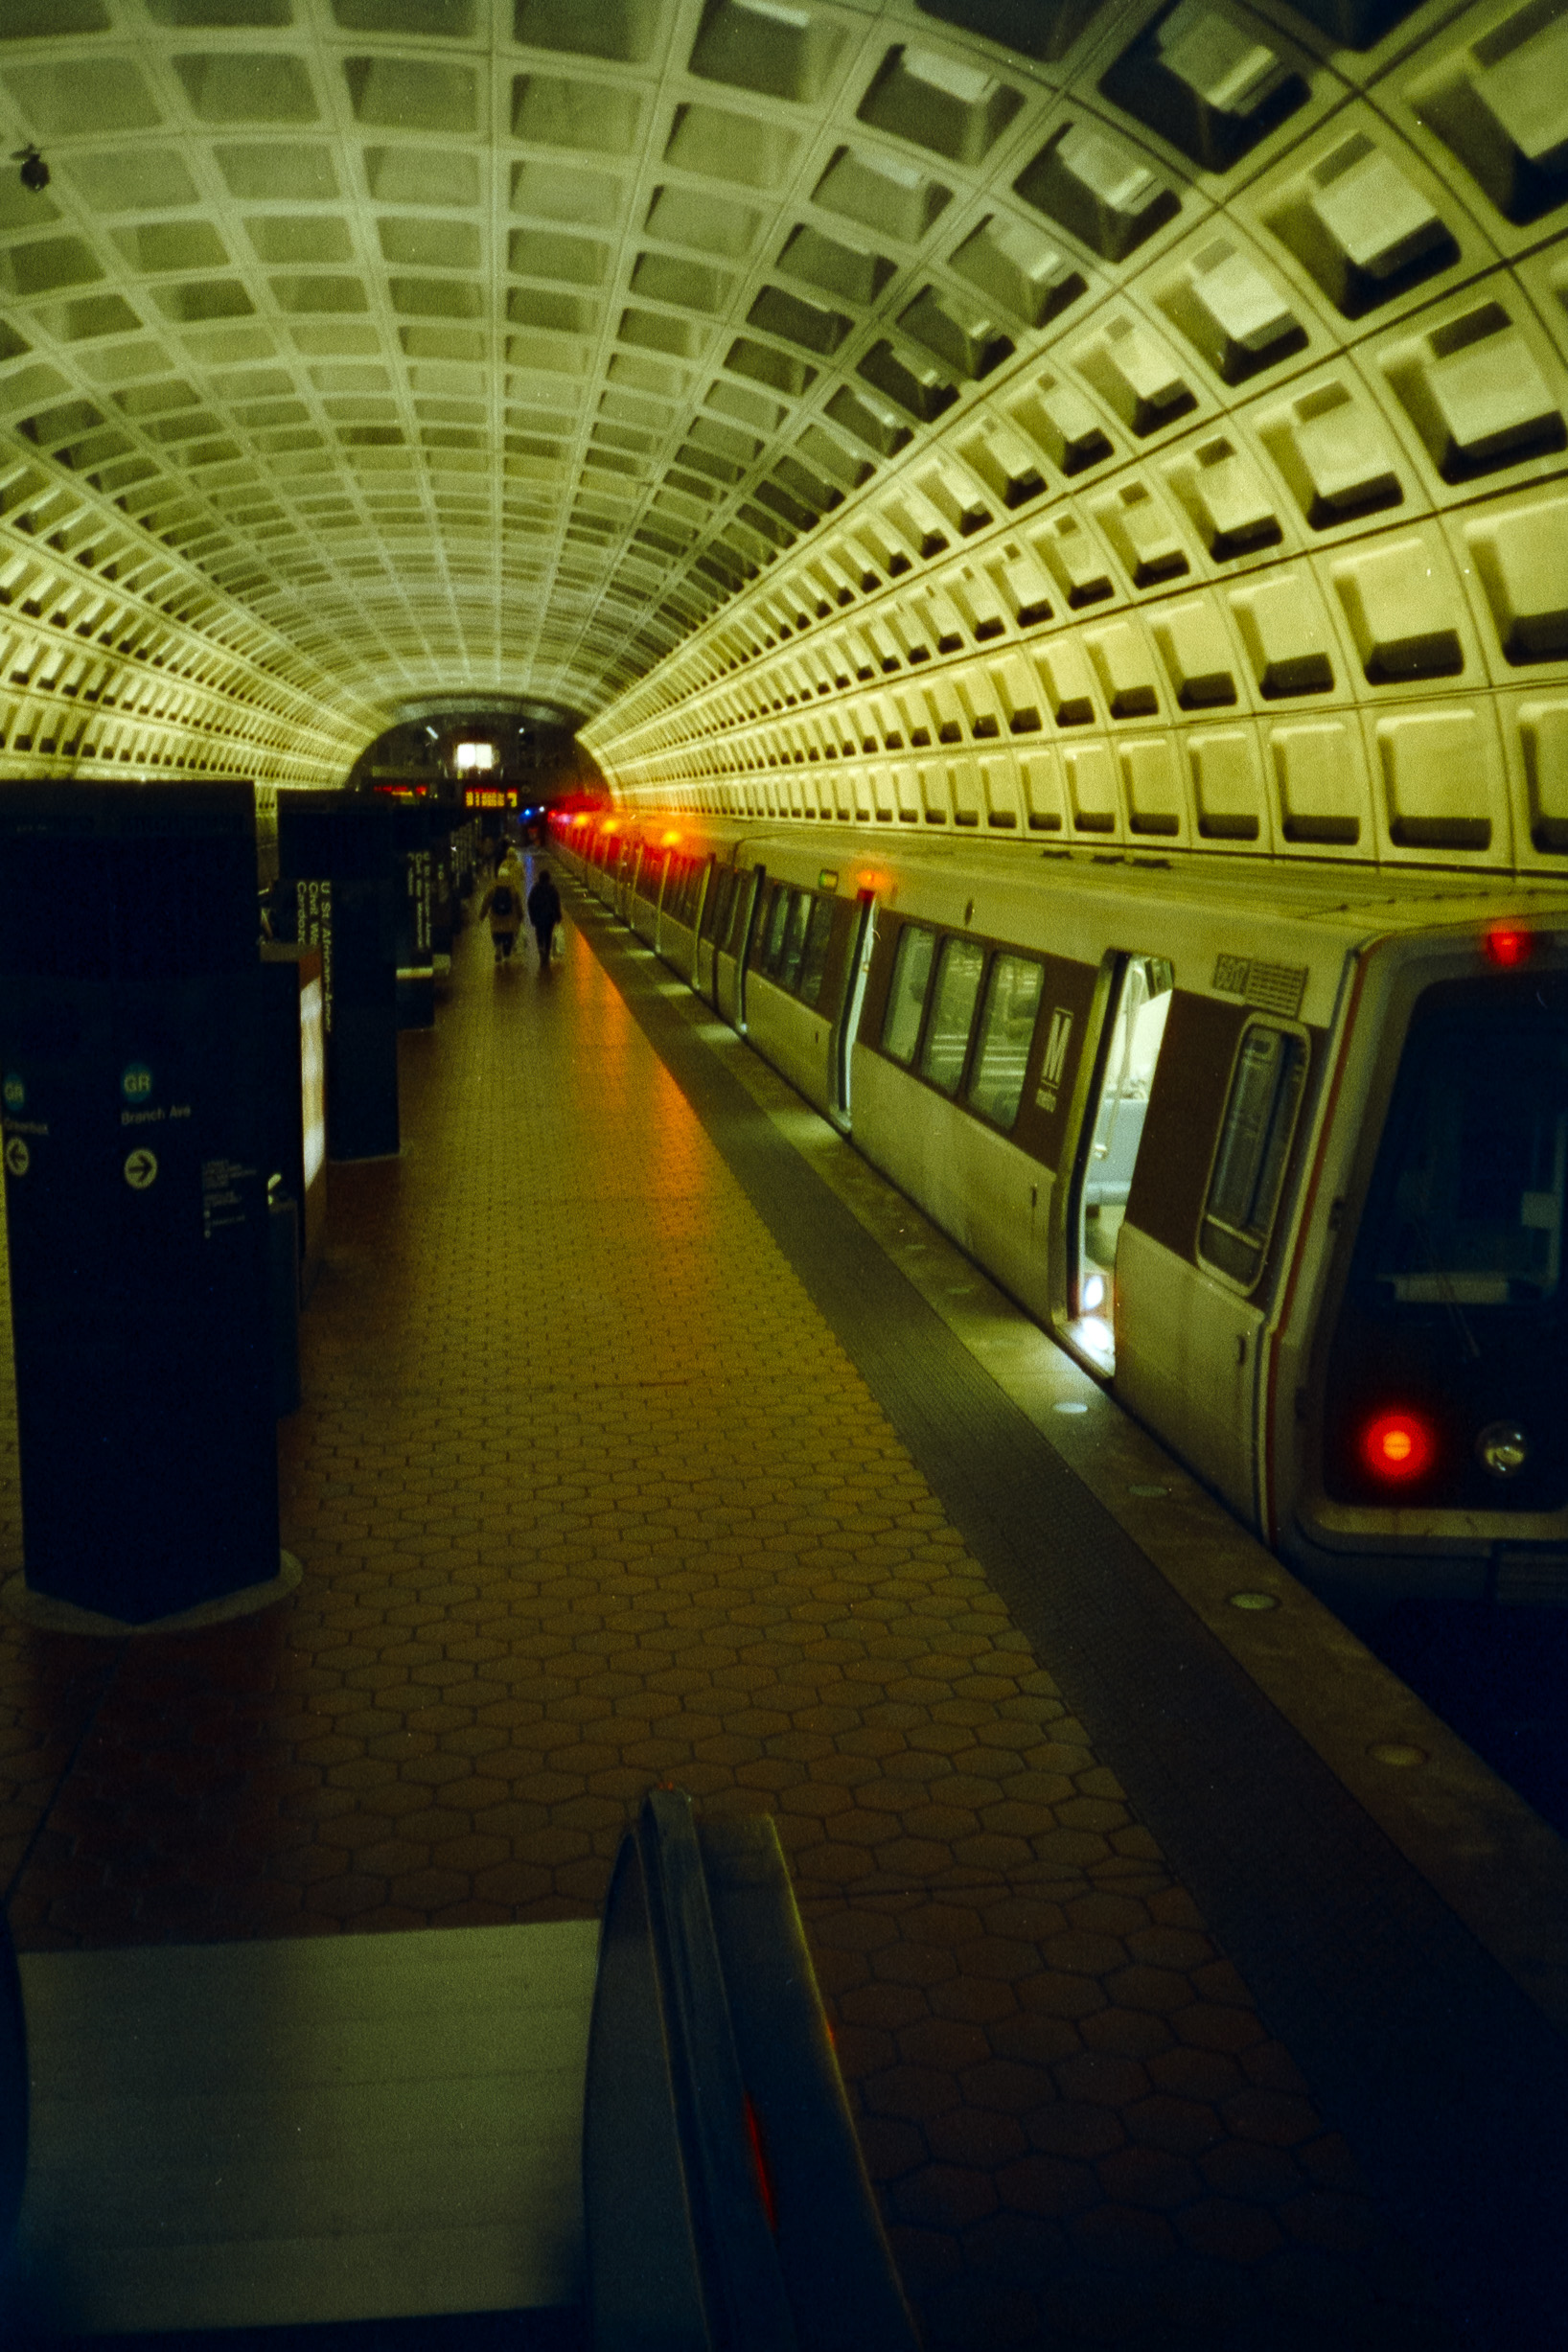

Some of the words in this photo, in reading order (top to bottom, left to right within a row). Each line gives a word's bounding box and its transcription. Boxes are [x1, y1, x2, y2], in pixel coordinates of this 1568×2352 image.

[309, 881, 318, 915] Civil
[320, 881, 332, 893] U
[309, 922, 318, 946] Wa
[4, 1081, 25, 1103] GR
[124, 1072, 151, 1094] GR
[121, 1107, 165, 1126] Branch
[169, 1104, 192, 1119] Ave
